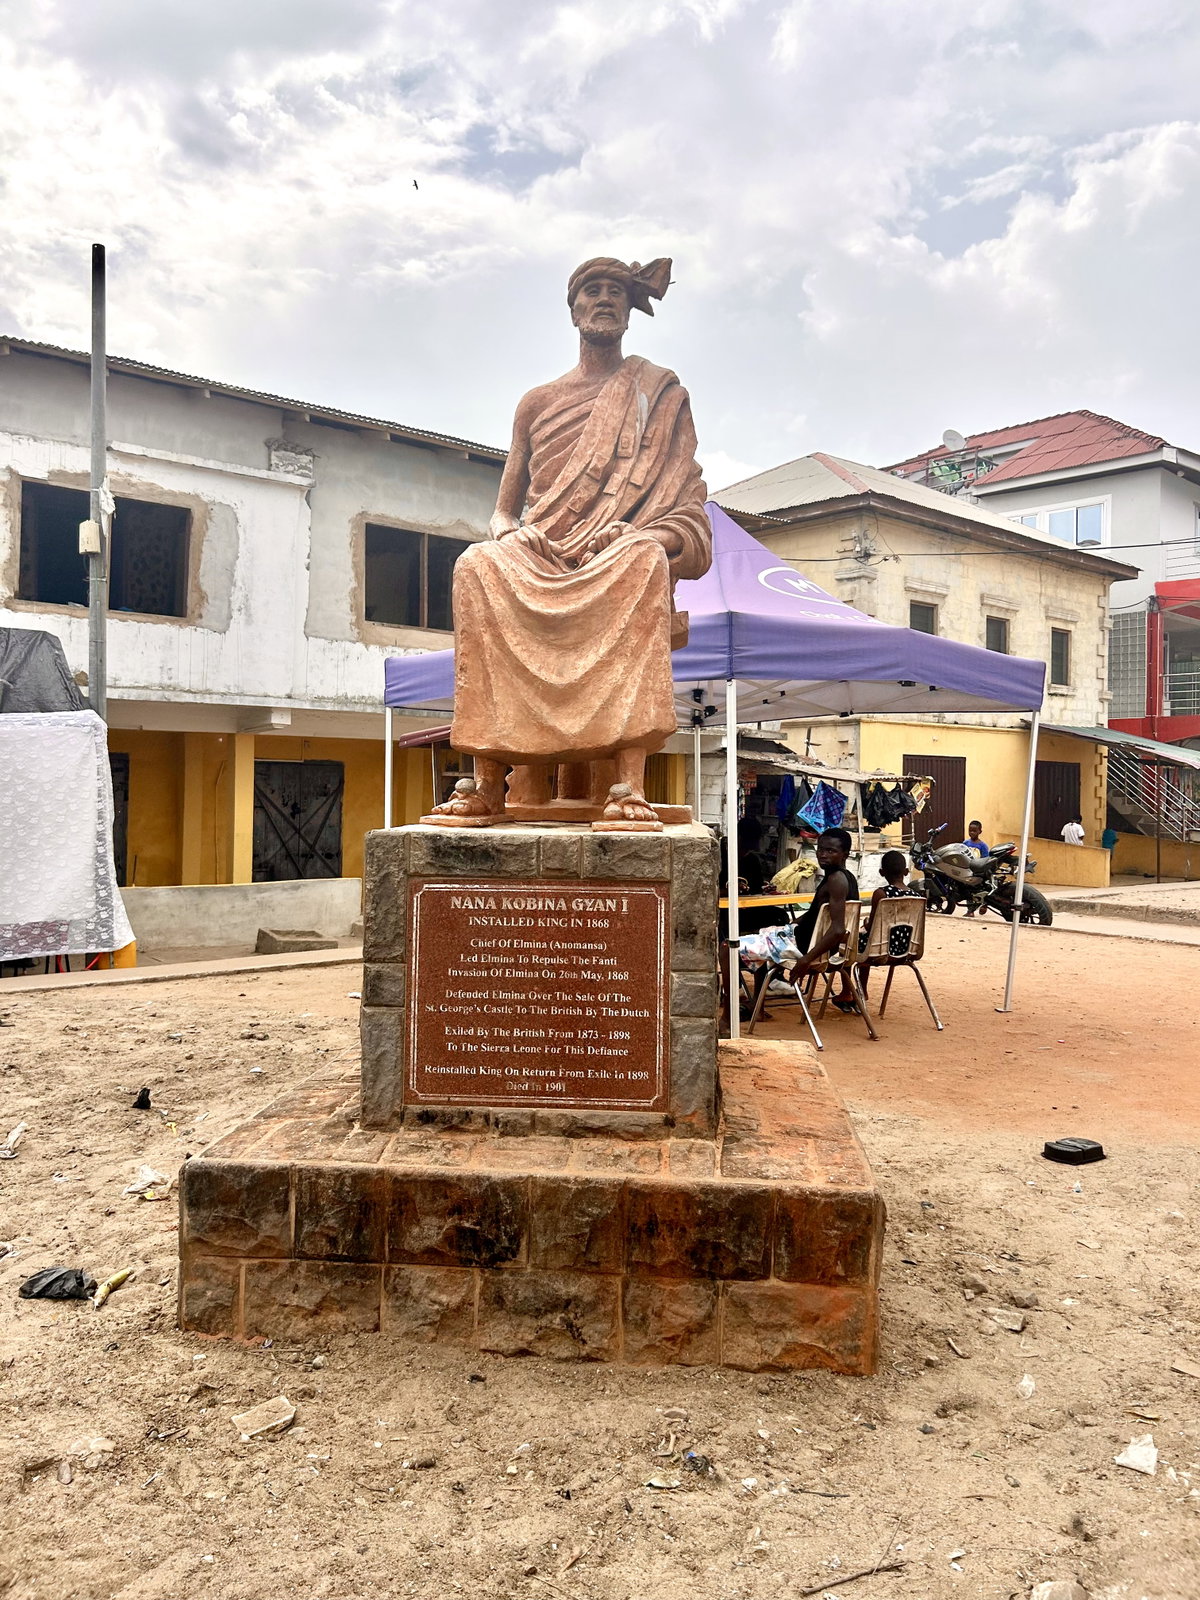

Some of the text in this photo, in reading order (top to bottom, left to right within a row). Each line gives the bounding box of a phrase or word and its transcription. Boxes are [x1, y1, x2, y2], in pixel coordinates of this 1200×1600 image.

[450, 896, 629, 914] NANA KOBINA GYAN I
[469, 917, 610, 928] INSTALLED KING IN 1868
[470, 939, 607, 951] Chief Of Elmina (Anomansa)
[460, 954, 617, 966] Led Elmina To Repulse The Fanti
[448, 968, 488, 977] Invasion
[490, 968, 503, 977] Of
[505, 969, 539, 978] Elmina
[541, 969, 556, 979] On
[559, 970, 579, 979] 26th
[607, 971, 629, 980] 1868
[445, 989, 631, 1002] Defended Elmina Over The Sale Of The
[425, 1003, 650, 1017] St. George's Castle To The British By The Dutch
[445, 1027, 474, 1036] Exiled
[477, 1027, 490, 1039] By
[493, 1028, 511, 1037] The
[513, 1028, 545, 1038] British
[548, 1029, 574, 1038] From
[577, 1030, 599, 1039] 1873
[608, 1031, 631, 1040] 1898
[446, 1042, 629, 1056] To The Sierra Leone For This Defiance
[425, 1065, 477, 1075] Reinstalled
[479, 1066, 502, 1077] King
[505, 1067, 519, 1076] On
[522, 1067, 556, 1077] Return
[558, 1068, 585, 1078] From
[587, 1069, 611, 1079] Exile
[627, 1070, 649, 1080] 1898
[506, 1082, 529, 1091] Died
